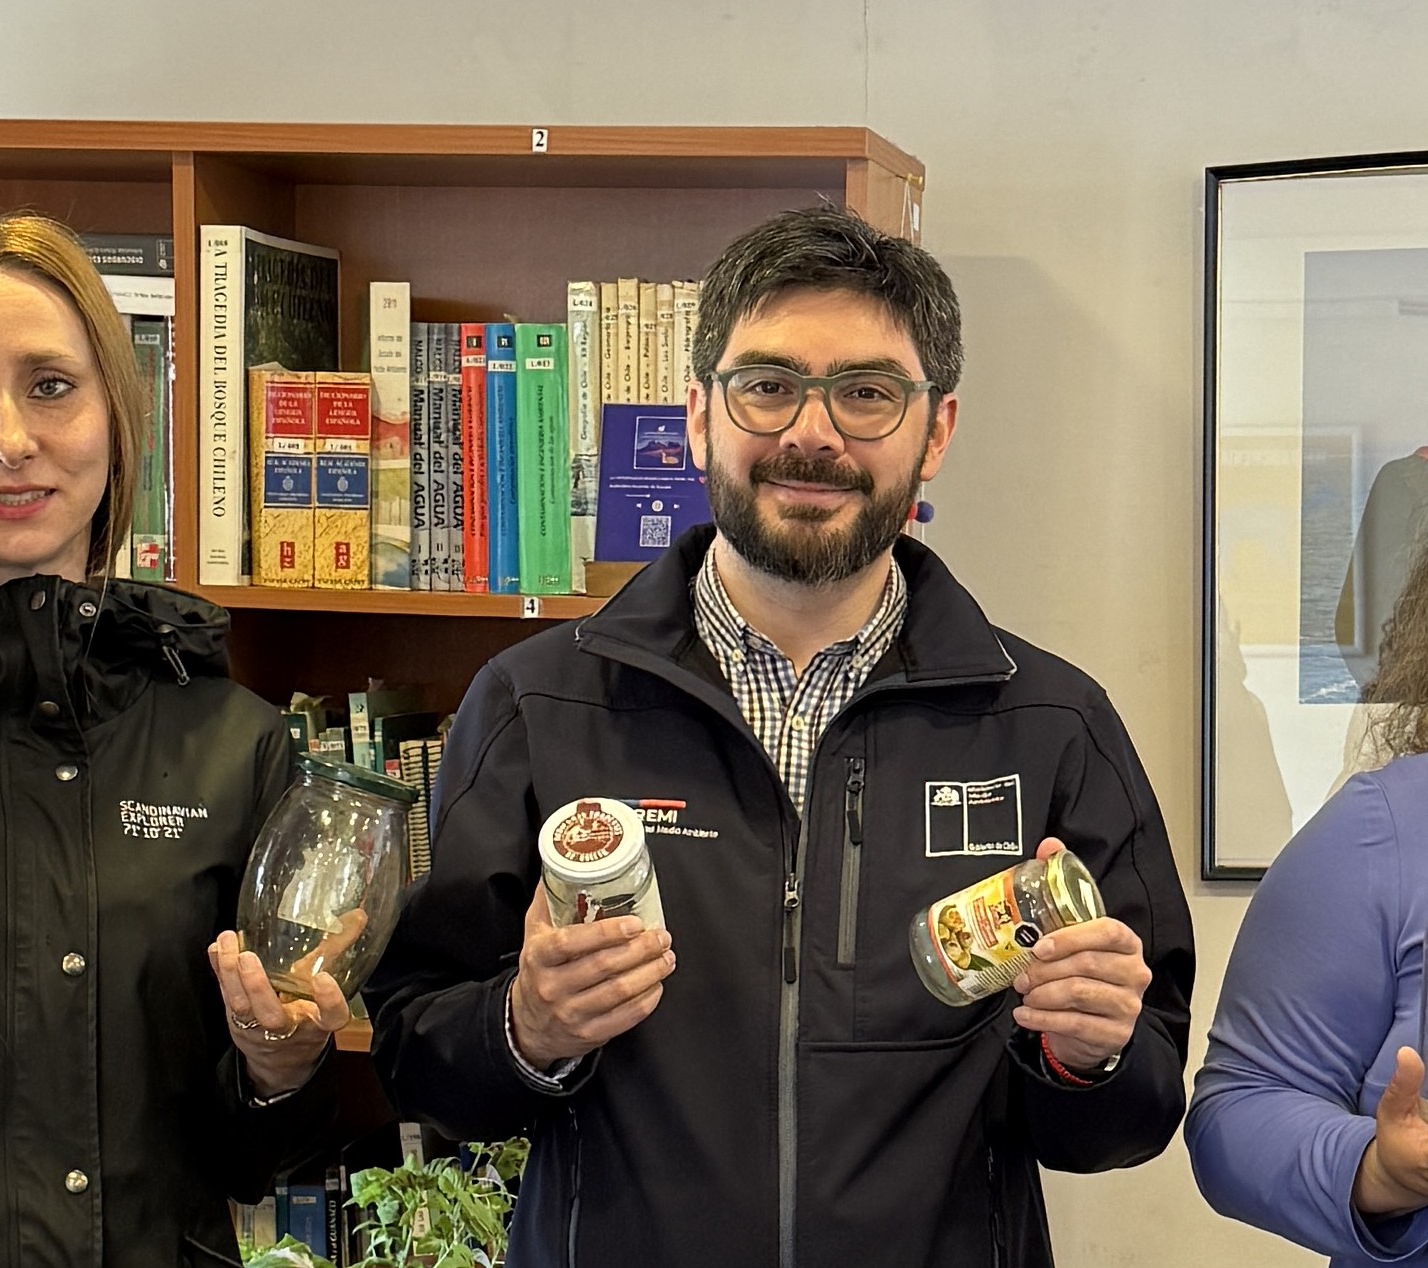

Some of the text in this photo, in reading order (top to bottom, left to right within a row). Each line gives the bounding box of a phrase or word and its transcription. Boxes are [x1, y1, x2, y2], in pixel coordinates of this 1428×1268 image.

[535, 130, 545, 147] 2
[213, 262, 228, 340] TRAGEDIA
[213, 344, 228, 375] DEL
[213, 380, 228, 443] BOSQUE
[414, 388, 426, 529] Manual del AGUA
[432, 387, 445, 528] Manual del AGUA
[212, 447, 228, 517] CHILENO
[452, 482, 465, 529] AGUA
[526, 599, 536, 614] 4
[119, 800, 208, 818] SCANDINAVIAN
[120, 811, 185, 828] EXPLORER
